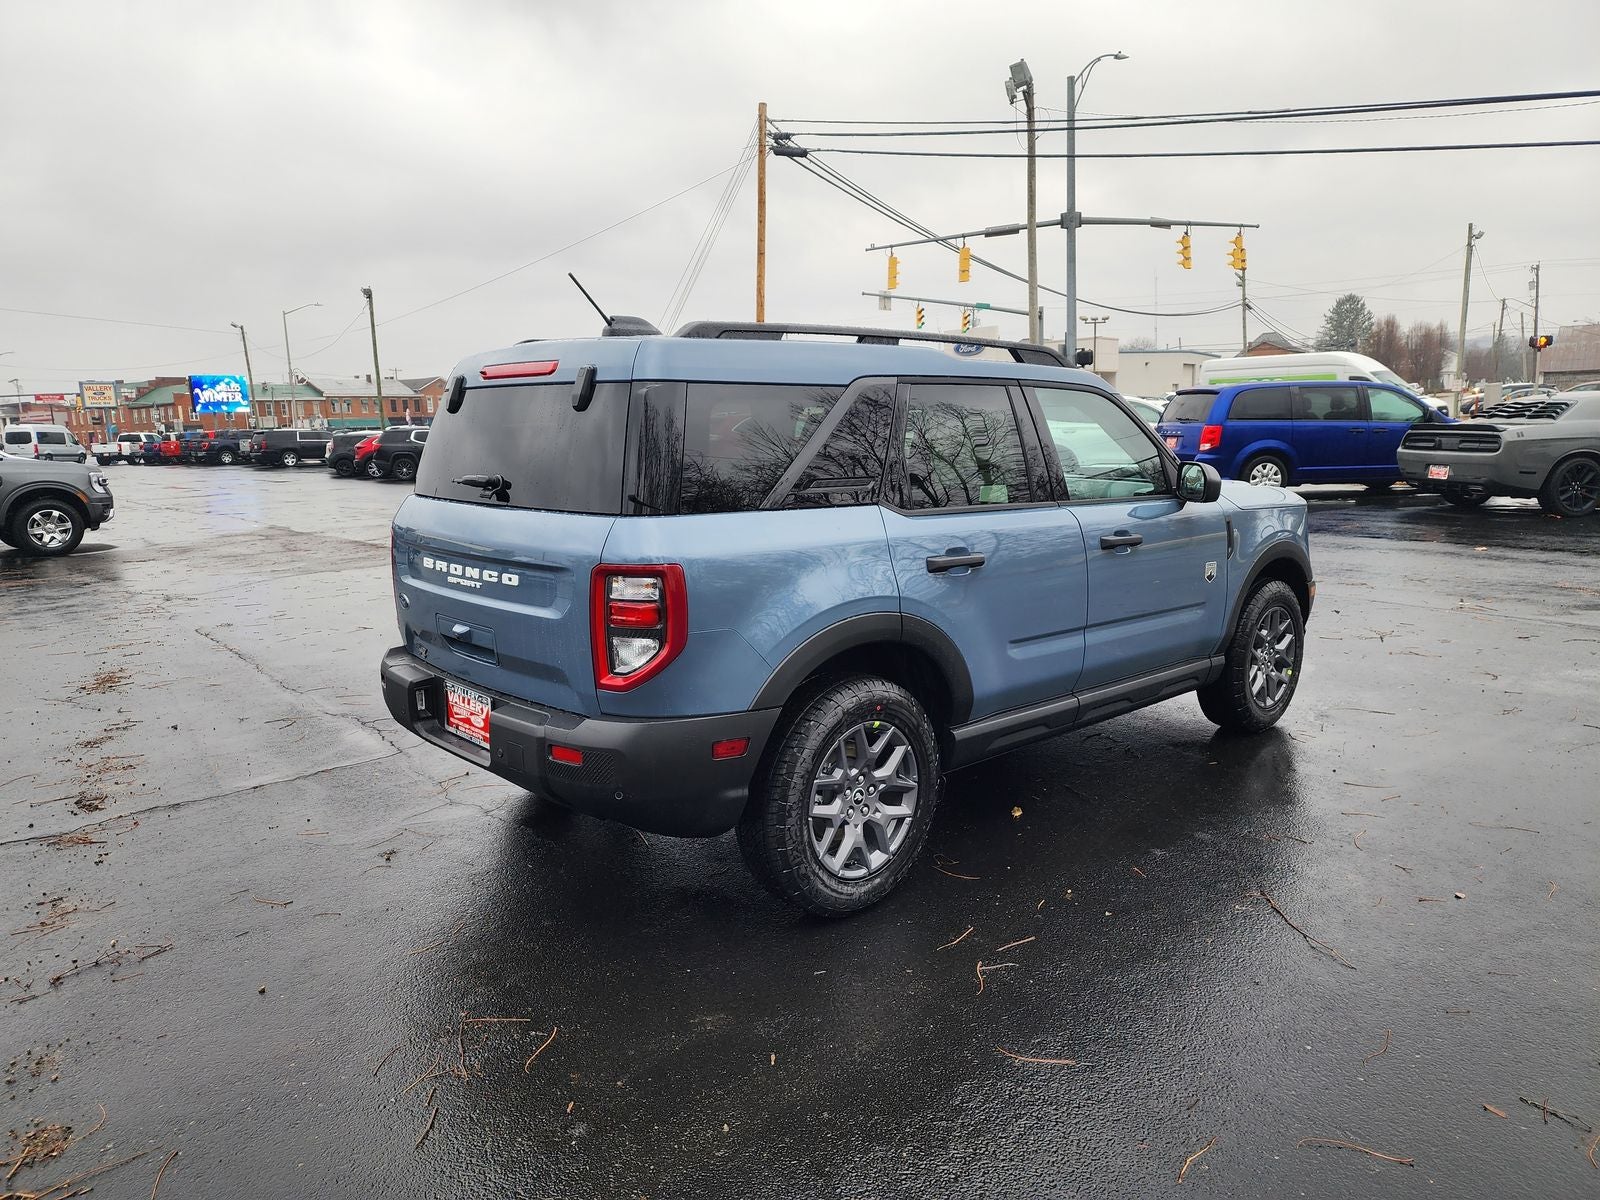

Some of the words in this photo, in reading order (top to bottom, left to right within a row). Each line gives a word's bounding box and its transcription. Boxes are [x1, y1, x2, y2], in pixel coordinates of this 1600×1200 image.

[959, 344, 977, 353] Ford
[193, 388, 248, 405] WINTER
[423, 557, 519, 586] BRONCO
[447, 576, 483, 589] SPORT
[454, 685, 480, 700] VALLERY
[447, 690, 489, 719] VALLERY
